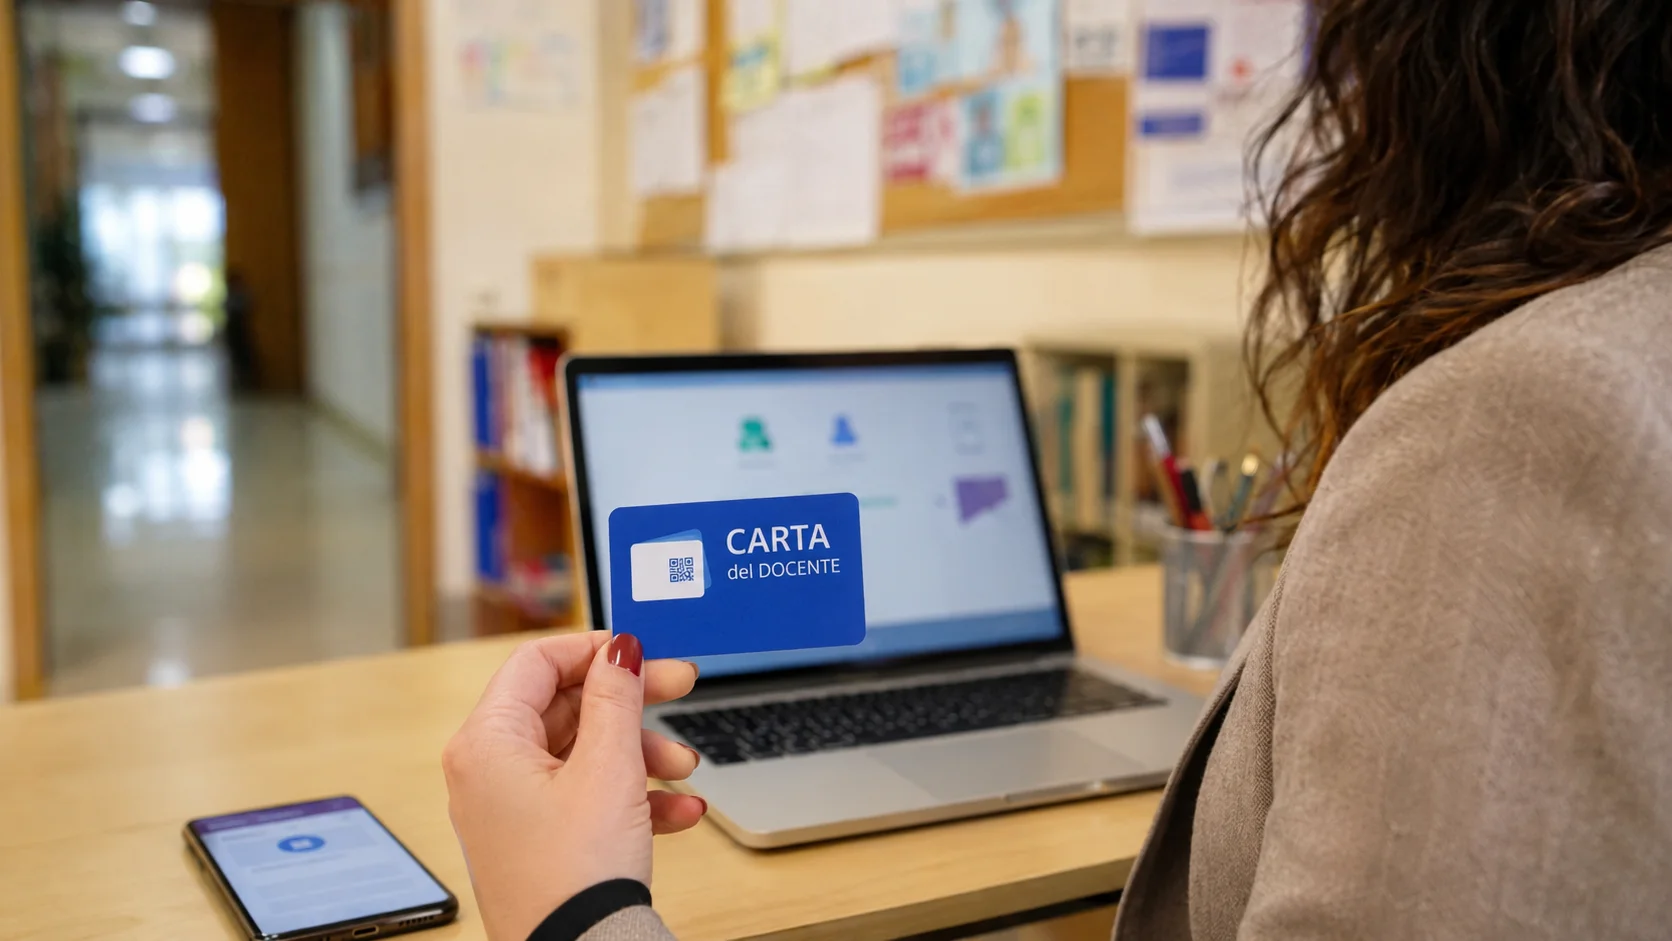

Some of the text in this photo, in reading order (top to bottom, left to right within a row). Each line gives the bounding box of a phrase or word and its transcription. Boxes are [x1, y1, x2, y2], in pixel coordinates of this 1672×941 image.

[726, 523, 831, 555] CARTA
[727, 558, 841, 580] del DOCENTE
